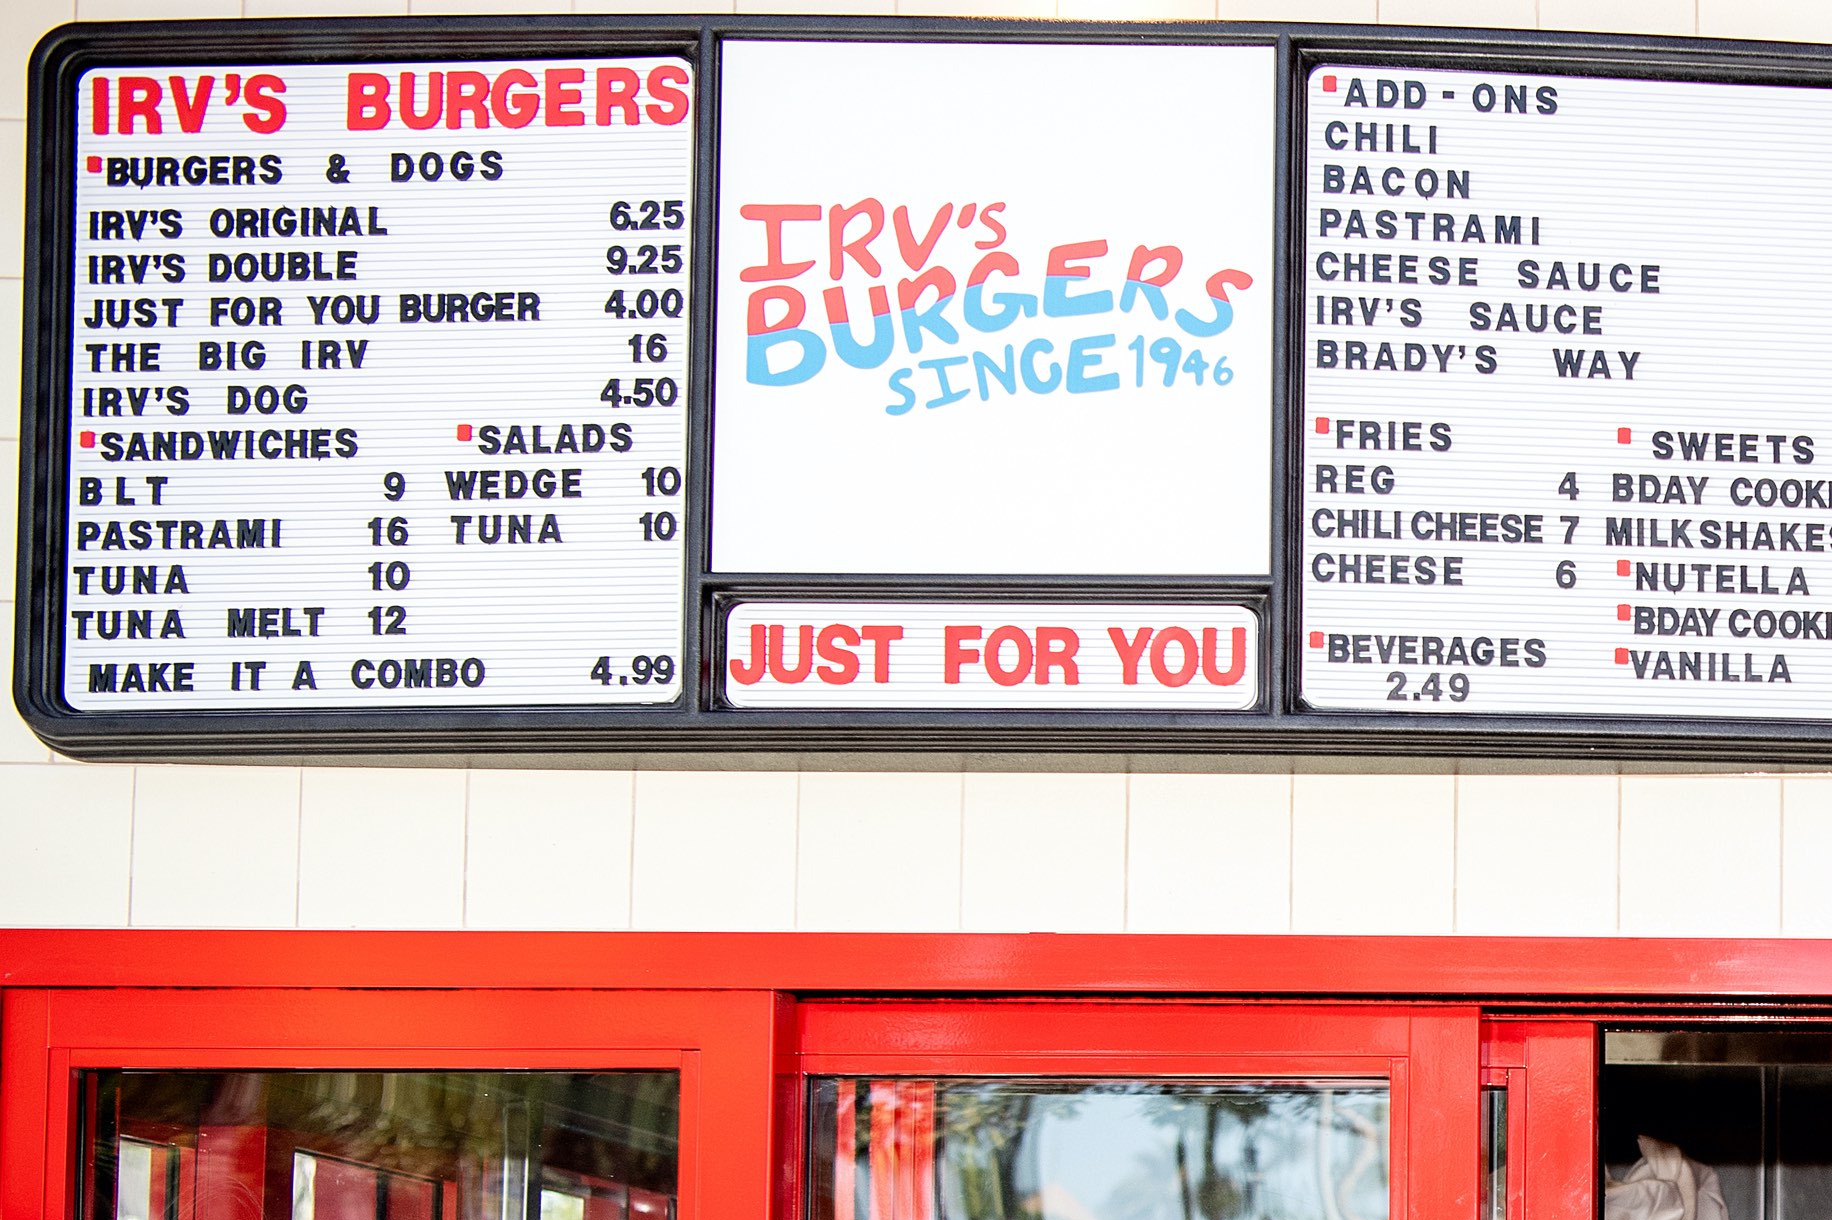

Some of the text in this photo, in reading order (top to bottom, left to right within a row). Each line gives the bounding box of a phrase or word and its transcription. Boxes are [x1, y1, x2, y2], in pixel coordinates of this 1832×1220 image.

[93, 66, 689, 136] IRV'S BURGERS
[1325, 121, 1436, 154] CHILI
[107, 151, 503, 190] BURGERS & DOGS
[1324, 165, 1469, 199] BACON
[90, 200, 684, 241] IRV'S ORIGINAL 6.25
[1320, 209, 1539, 245] PASTRAMI
[739, 197, 1006, 281] IRV'S
[89, 245, 682, 284] IRV'S DOUBLE 9.25
[1316, 252, 1478, 286] CHEESE
[1518, 260, 1659, 293] SAUCE
[84, 289, 683, 329] JUST FOR YOU BURGER 4.00
[746, 239, 1254, 387] BURGERS
[1317, 296, 1422, 327] IRV'S
[1470, 302, 1602, 334] SAUCE
[86, 334, 667, 372] THE BIG IRV 16
[1317, 340, 1497, 374] BRADY'S
[1553, 349, 1640, 379] WAY
[885, 334, 1232, 416] SINCE 1946
[84, 377, 677, 417] IRV'S DOG 4.50
[101, 428, 358, 462] SANDWICHES
[478, 423, 633, 455] SALADS
[1337, 420, 1451, 451] FRIES
[1652, 431, 1814, 464] SWEETS
[384, 472, 405, 501] 9
[445, 467, 681, 500] WEDGE 10
[1316, 465, 1579, 500] REG 4
[1613, 473, 1709, 504] BDAY
[78, 517, 408, 551] PASTRAMI 16
[451, 512, 676, 545] TUNA 10
[1312, 508, 1579, 544] CHILI CHEESE 7
[73, 561, 410, 595] TUNA 10
[1312, 553, 1576, 588] CHEESE 6
[1636, 562, 1809, 595] NUTELLA
[72, 606, 406, 640] TUNA MELT 12
[1634, 606, 1720, 636] BDAY
[730, 624, 1246, 687] JUST FOR YOU
[1329, 634, 1546, 667] BEVERAGES
[1629, 651, 1791, 683] VANILLA
[89, 655, 674, 693] MAKE IT A COMBO 4.99
[1387, 672, 1469, 701] 2.49
